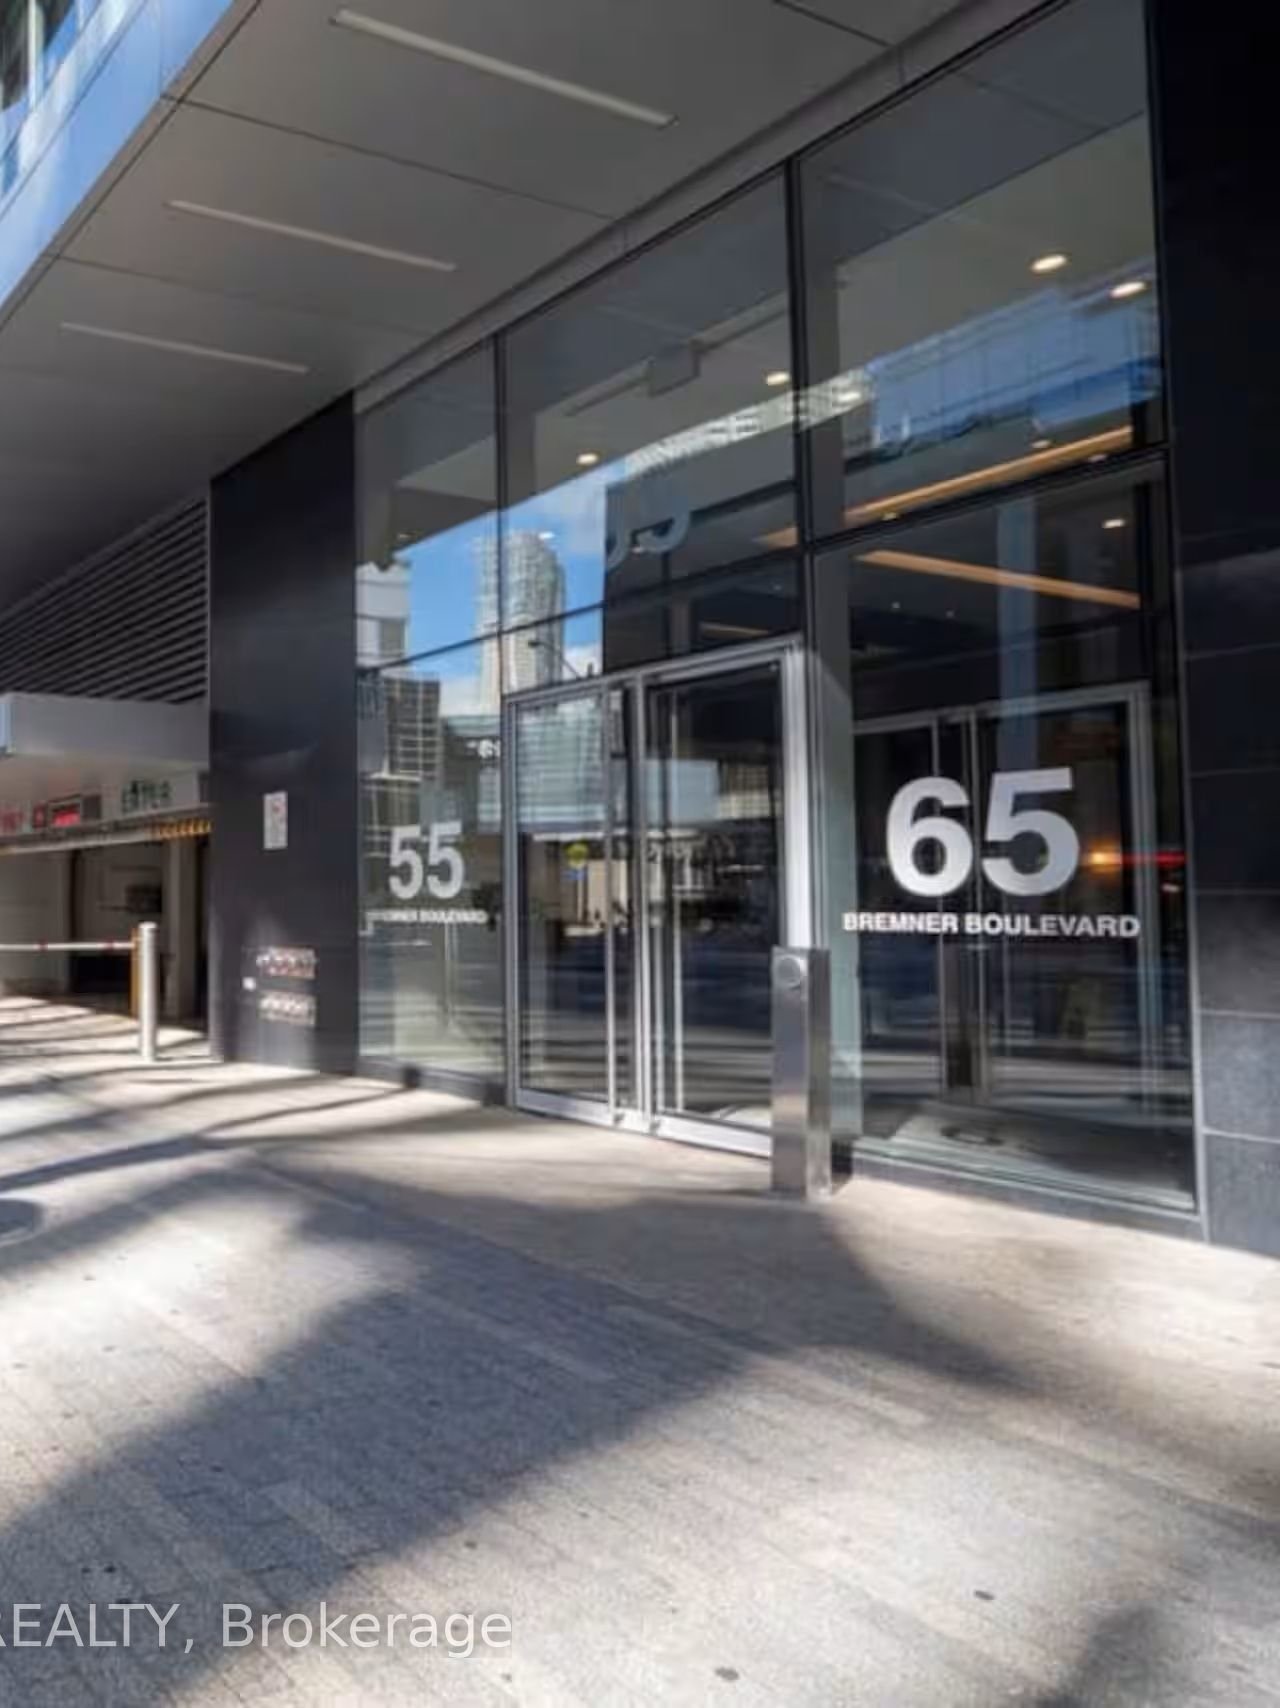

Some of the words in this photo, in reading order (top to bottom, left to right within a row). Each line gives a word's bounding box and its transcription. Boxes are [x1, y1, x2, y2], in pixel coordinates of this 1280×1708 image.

[388, 821, 464, 899] 55
[886, 767, 1080, 898] 65
[843, 911, 959, 935] BREMNER
[963, 913, 1142, 938] BOULEVARD
